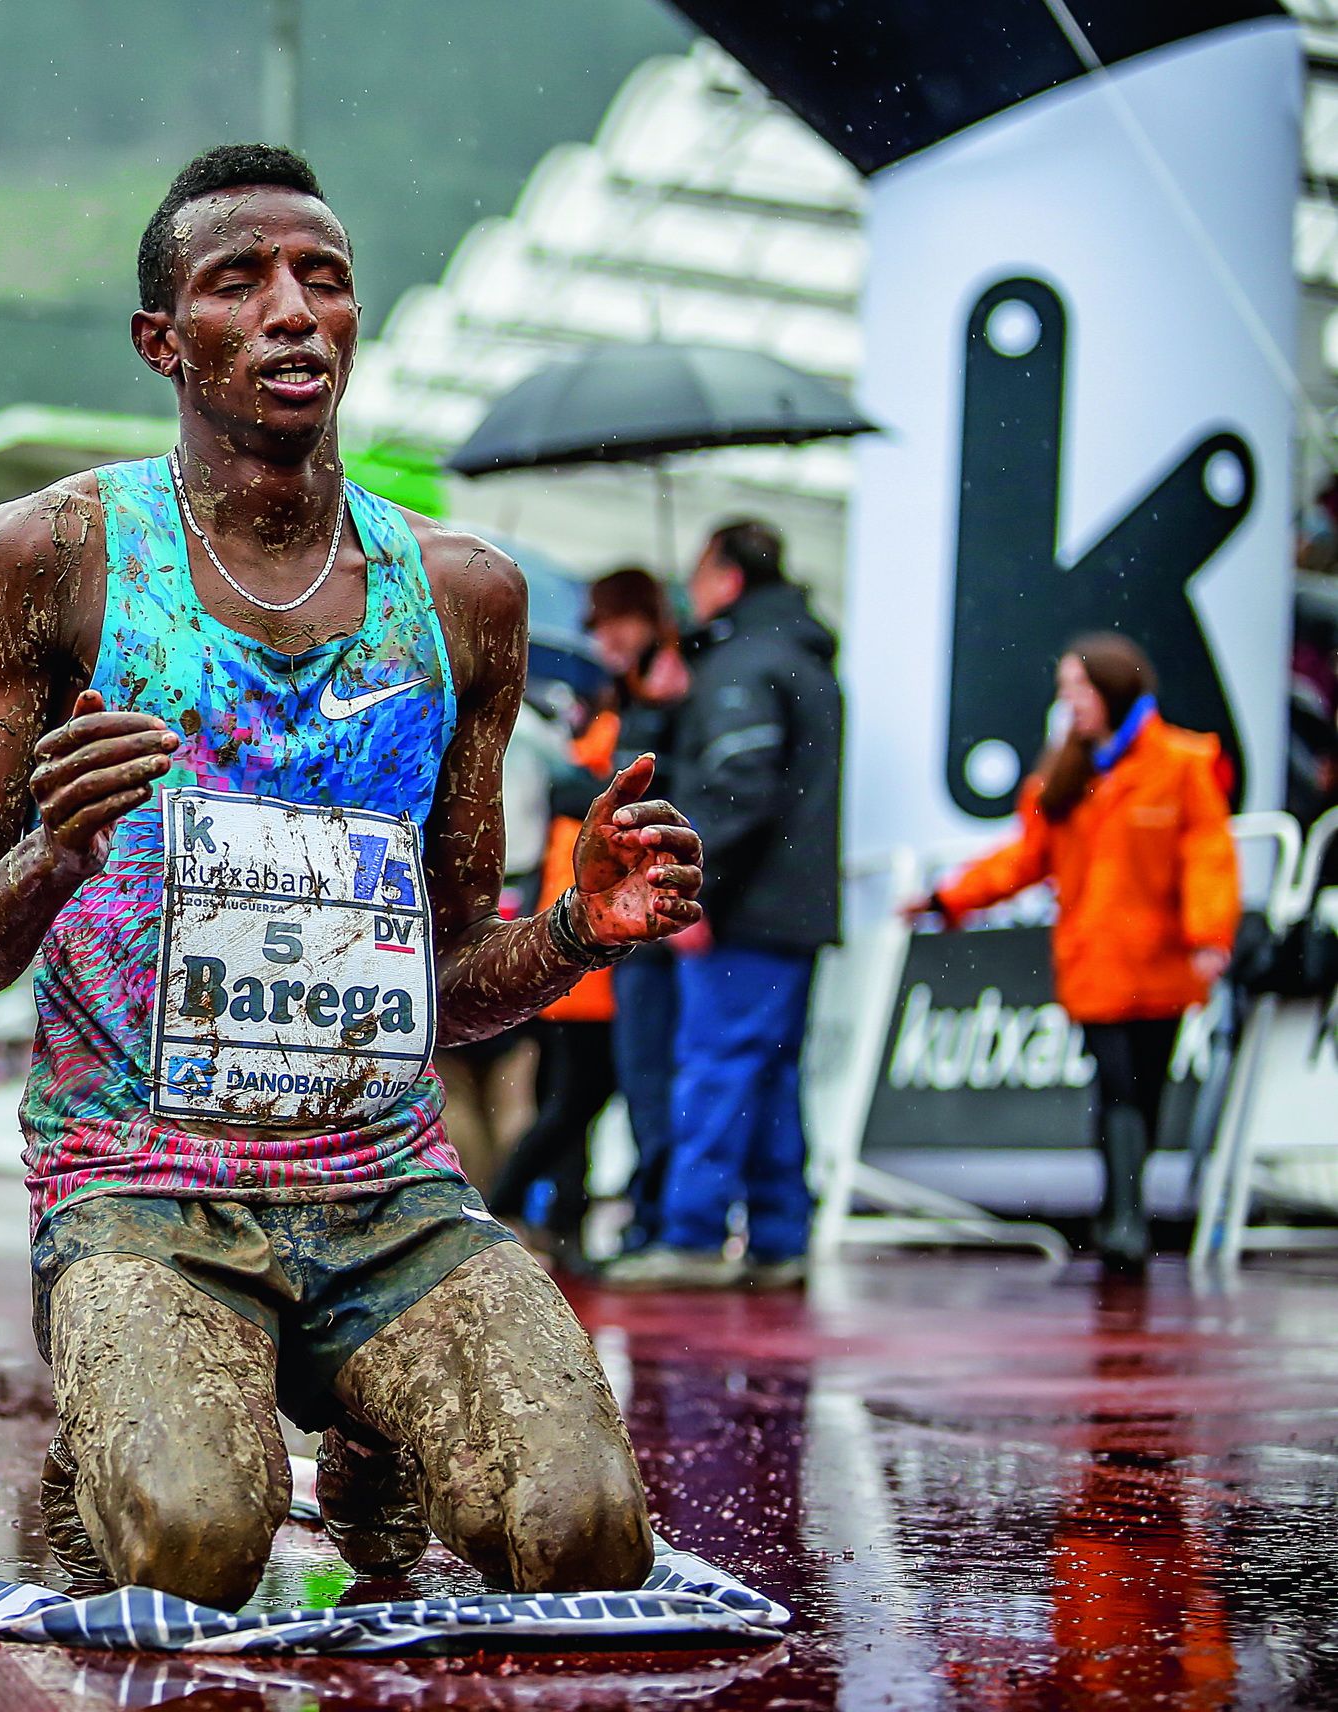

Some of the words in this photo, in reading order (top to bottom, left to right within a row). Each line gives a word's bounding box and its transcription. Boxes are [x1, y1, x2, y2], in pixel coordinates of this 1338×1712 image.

[182, 854, 331, 897] kutxabank
[178, 896, 216, 908] ROSS
[224, 900, 285, 914] MUGUERZA
[262, 921, 303, 965] 5
[374, 915, 413, 945] DV
[178, 955, 416, 1046] Barega
